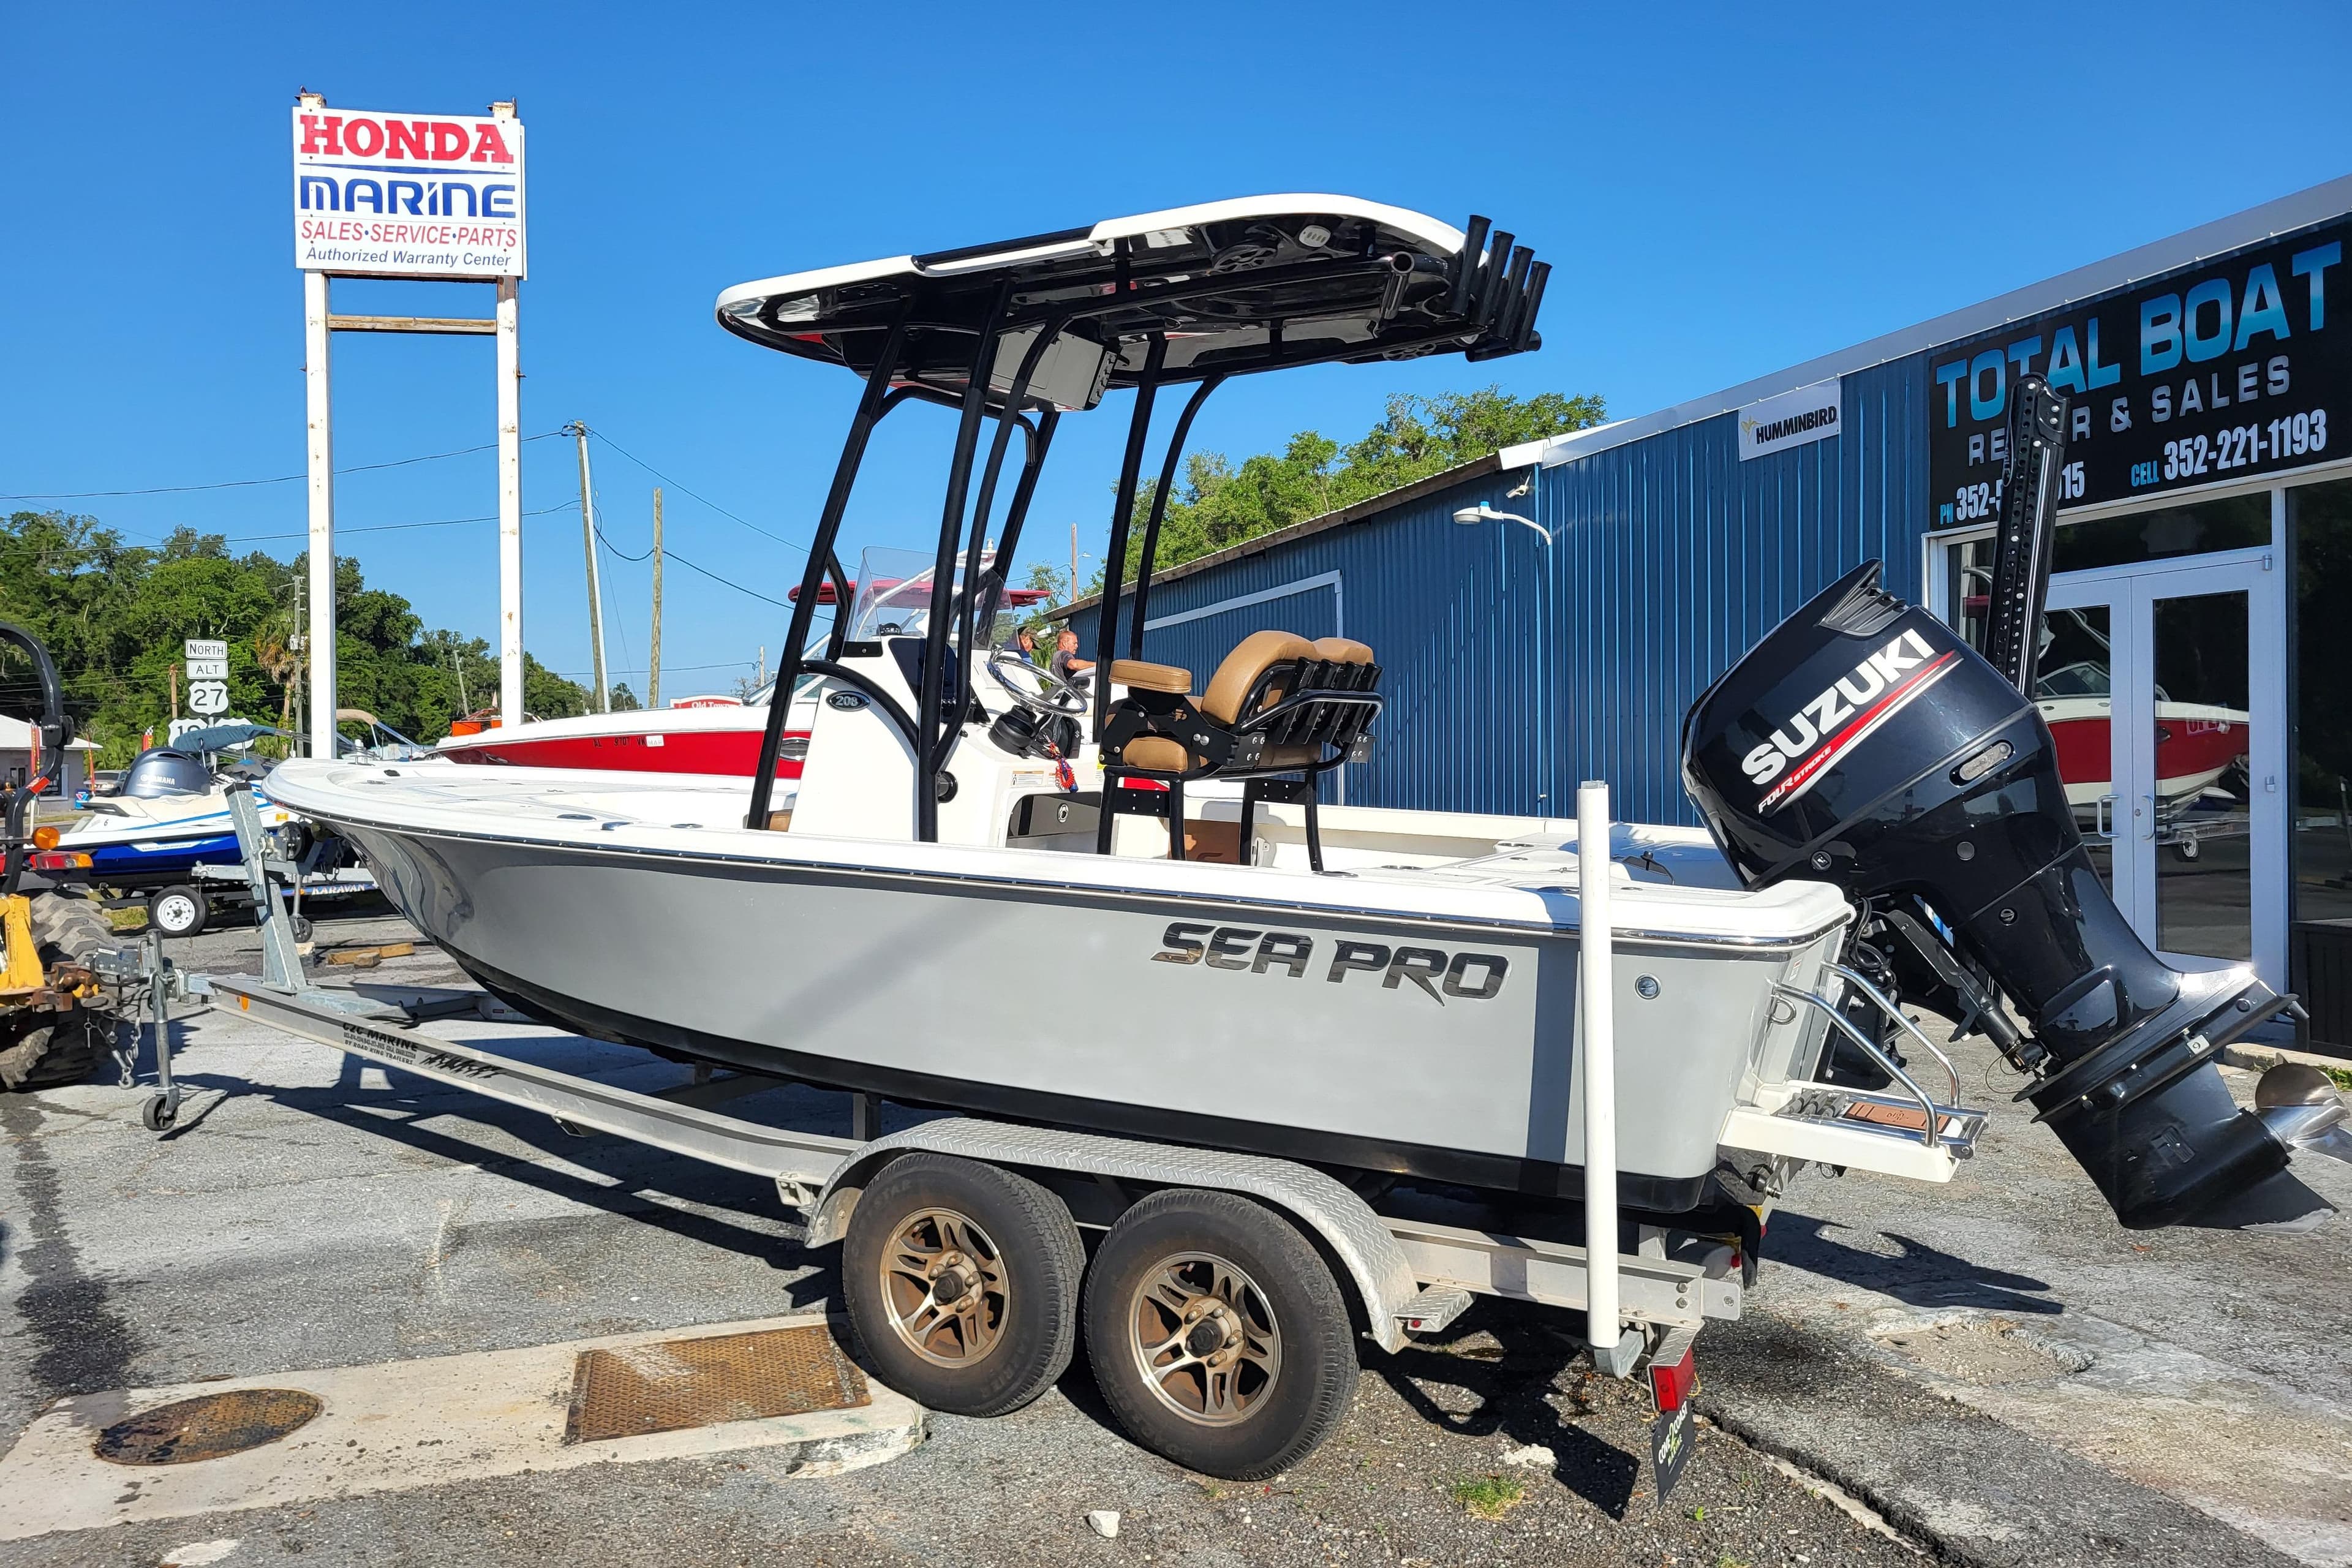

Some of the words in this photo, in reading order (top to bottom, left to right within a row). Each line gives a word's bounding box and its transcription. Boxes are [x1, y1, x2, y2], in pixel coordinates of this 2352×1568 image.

[300, 114, 514, 164] HONDA
[306, 247, 388, 263] Authorized
[393, 250, 458, 268] Warranty
[463, 252, 511, 266] Center
[1936, 317, 2121, 428] TOTAL
[2140, 240, 2342, 377] BOAT
[1968, 406, 2091, 467] RER
[2109, 396, 2132, 432] &
[2151, 355, 2291, 424] SALES
[1755, 405, 1837, 445] HUMMINBIRD
[1940, 502, 1954, 525] PH
[2130, 460, 2160, 488] CELL
[2163, 409, 2327, 481] 352-221-1193
[189, 643, 224, 655] NORTH
[196, 665, 219, 674] ALT
[194, 688, 224, 706] 27
[835, 695, 858, 707] 208
[1742, 629, 1936, 785] SUZUKI
[148, 774, 175, 785] AMAHA
[1758, 777, 1794, 814] FOUR
[1793, 745, 1832, 783] STROKE
[311, 884, 366, 895] KARAVAN
[1150, 922, 1314, 978] SEA
[1327, 939, 1510, 1008] PRO
[367, 1029, 418, 1052] MARINE
[353, 1041, 368, 1051] ROAD
[385, 1052, 413, 1065] TRAILERS
